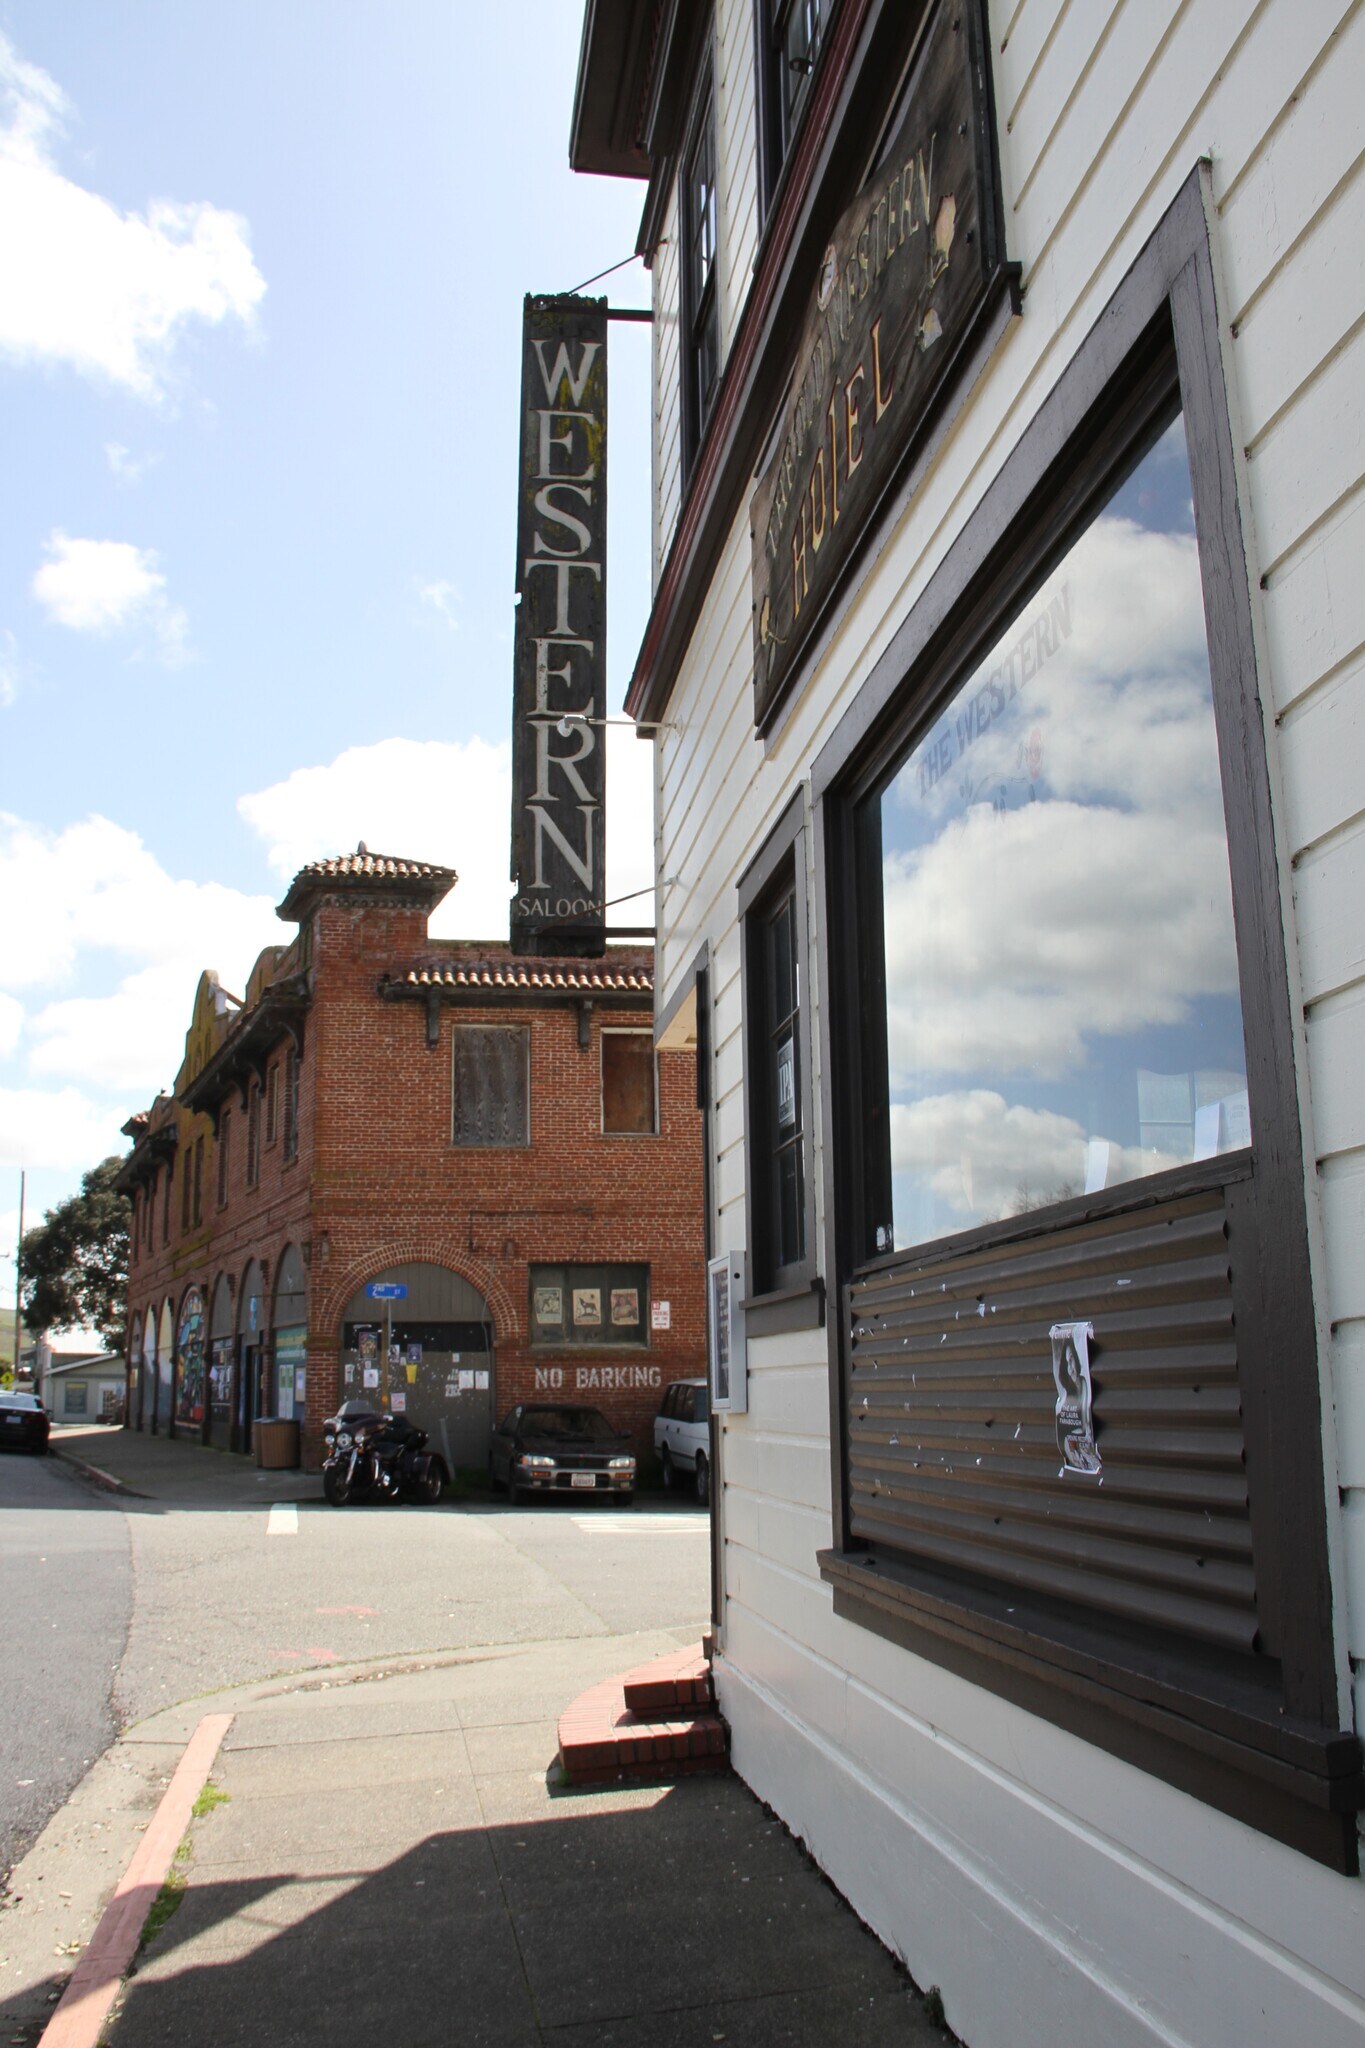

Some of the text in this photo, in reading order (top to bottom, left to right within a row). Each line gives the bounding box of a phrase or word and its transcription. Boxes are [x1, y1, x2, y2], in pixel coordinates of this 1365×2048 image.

[790, 312, 897, 621] HOTEL
[524, 337, 604, 891] WESTERN
[916, 579, 1074, 799] THE WESTERN
[518, 897, 603, 918] SALOON
[535, 1366, 662, 1389] NO BARKING
